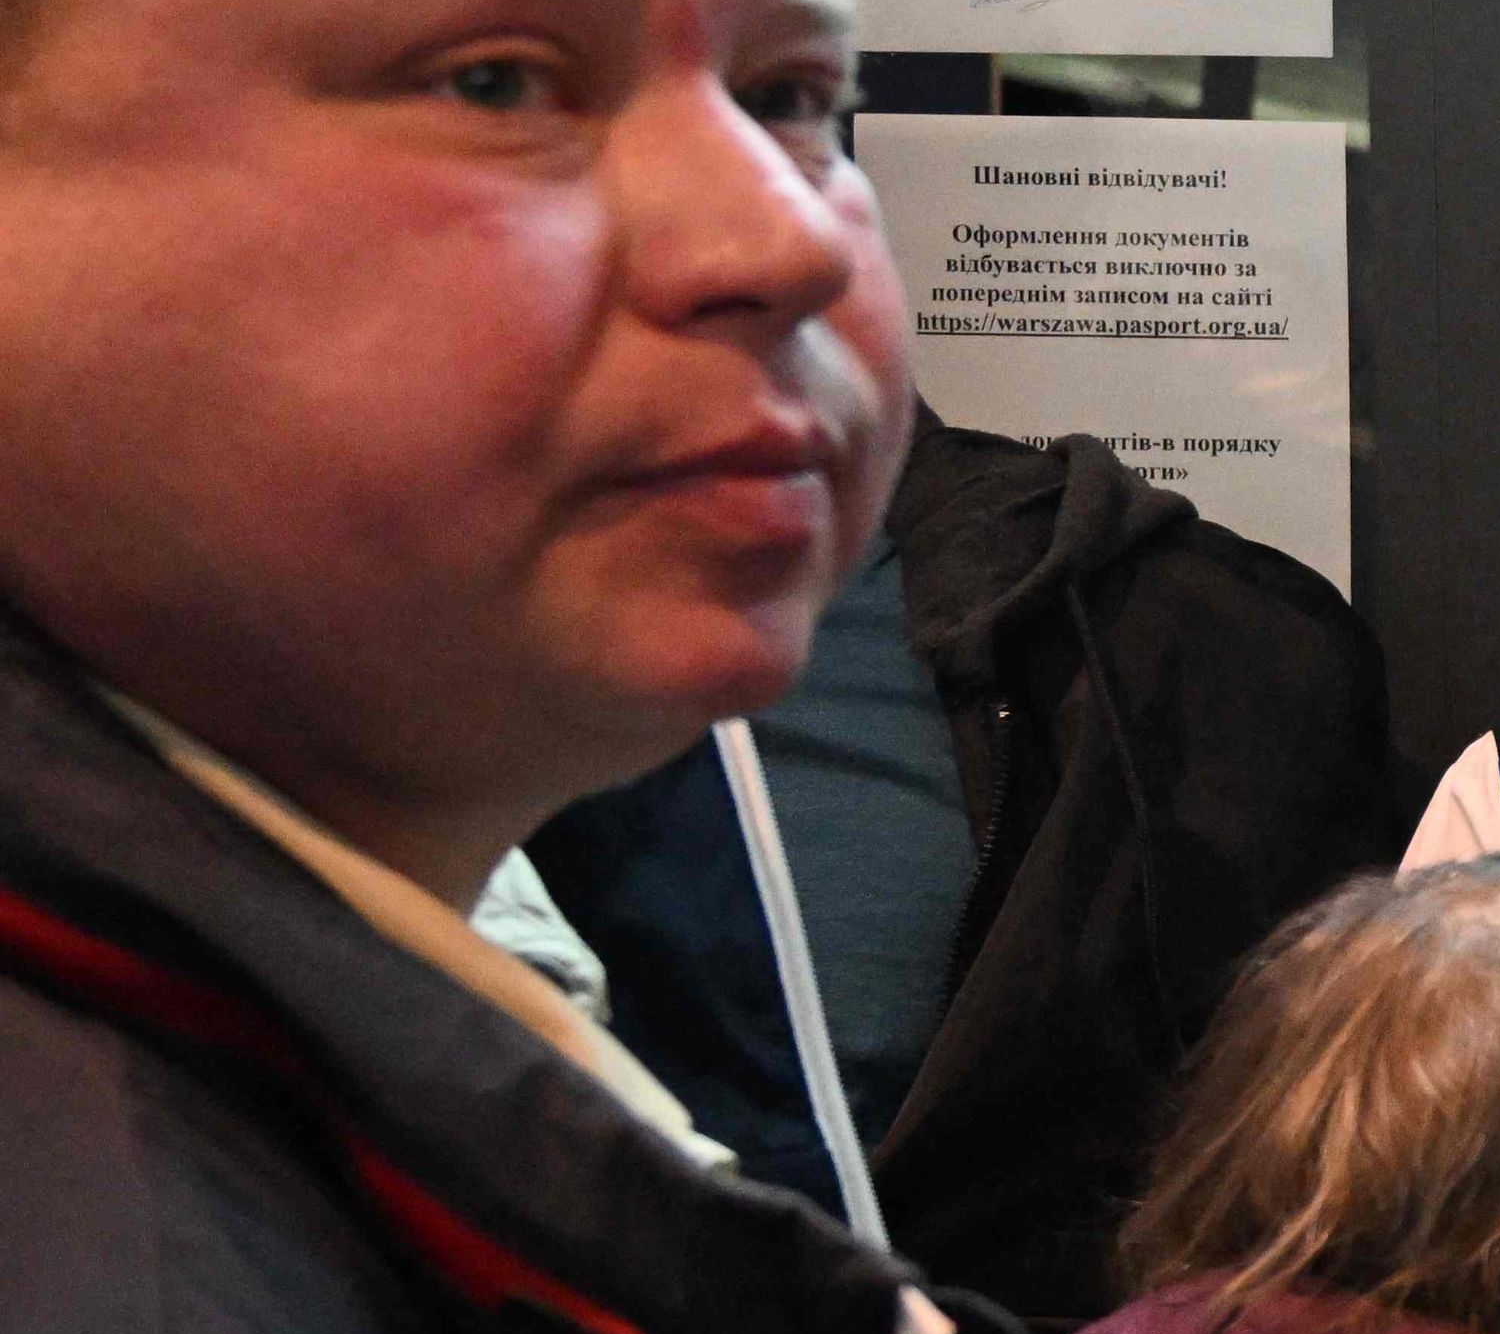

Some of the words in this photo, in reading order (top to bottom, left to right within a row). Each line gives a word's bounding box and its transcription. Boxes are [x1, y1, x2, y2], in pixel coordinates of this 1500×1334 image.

[973, 164, 1080, 187] Шановні
[1087, 167, 1228, 193] відвідувачі!
[952, 223, 1108, 249] Оформлення
[1115, 228, 1249, 253] документів
[945, 254, 1097, 279] відбувається
[1105, 261, 1227, 278] виключно
[1234, 262, 1257, 278] за
[931, 282, 1066, 309] попереднім
[1073, 289, 1169, 306] записом
[1176, 290, 1204, 306] на
[1211, 286, 1273, 307] сайті
[916, 311, 1289, 340] https://warszawa.pasport.org.ua/
[1183, 436, 1281, 456] порядку
